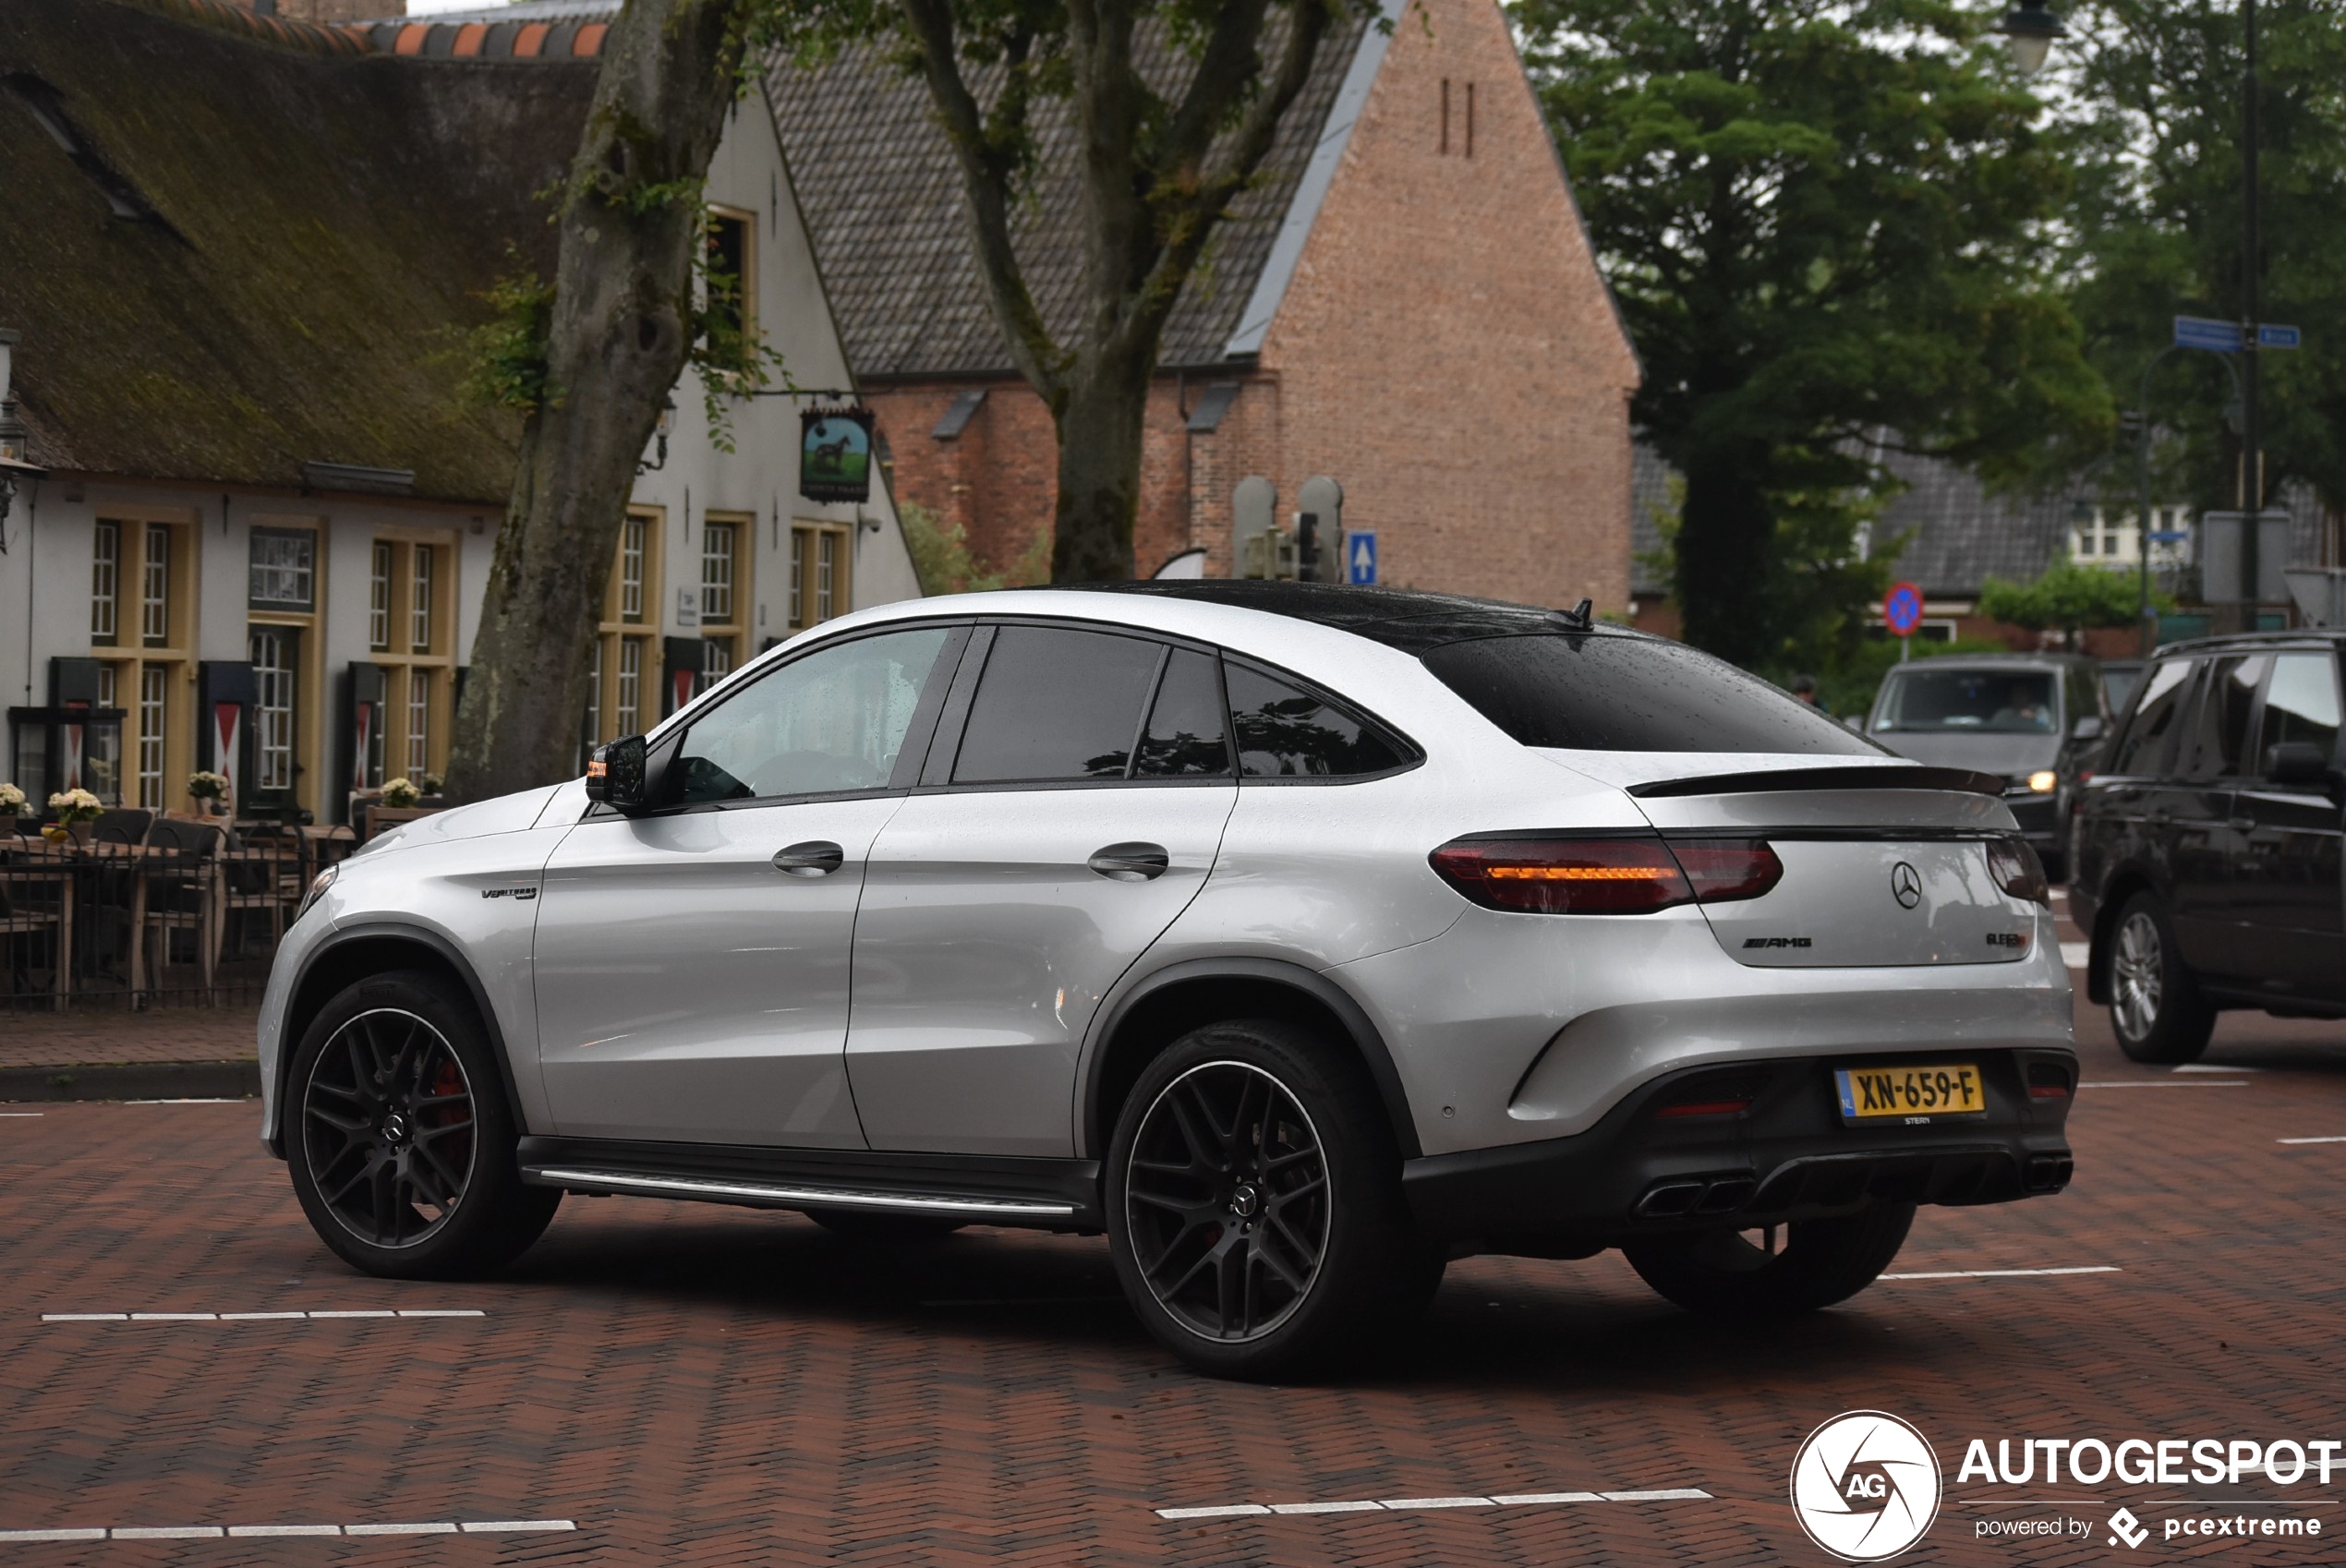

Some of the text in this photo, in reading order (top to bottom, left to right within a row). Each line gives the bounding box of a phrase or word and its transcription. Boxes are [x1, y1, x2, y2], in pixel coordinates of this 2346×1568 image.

[1765, 937, 1812, 947] AMG
[1857, 1071, 1975, 1110] XN-659-F
[1842, 1099, 1854, 1109] NL
[1905, 1116, 1930, 1125] STERN
